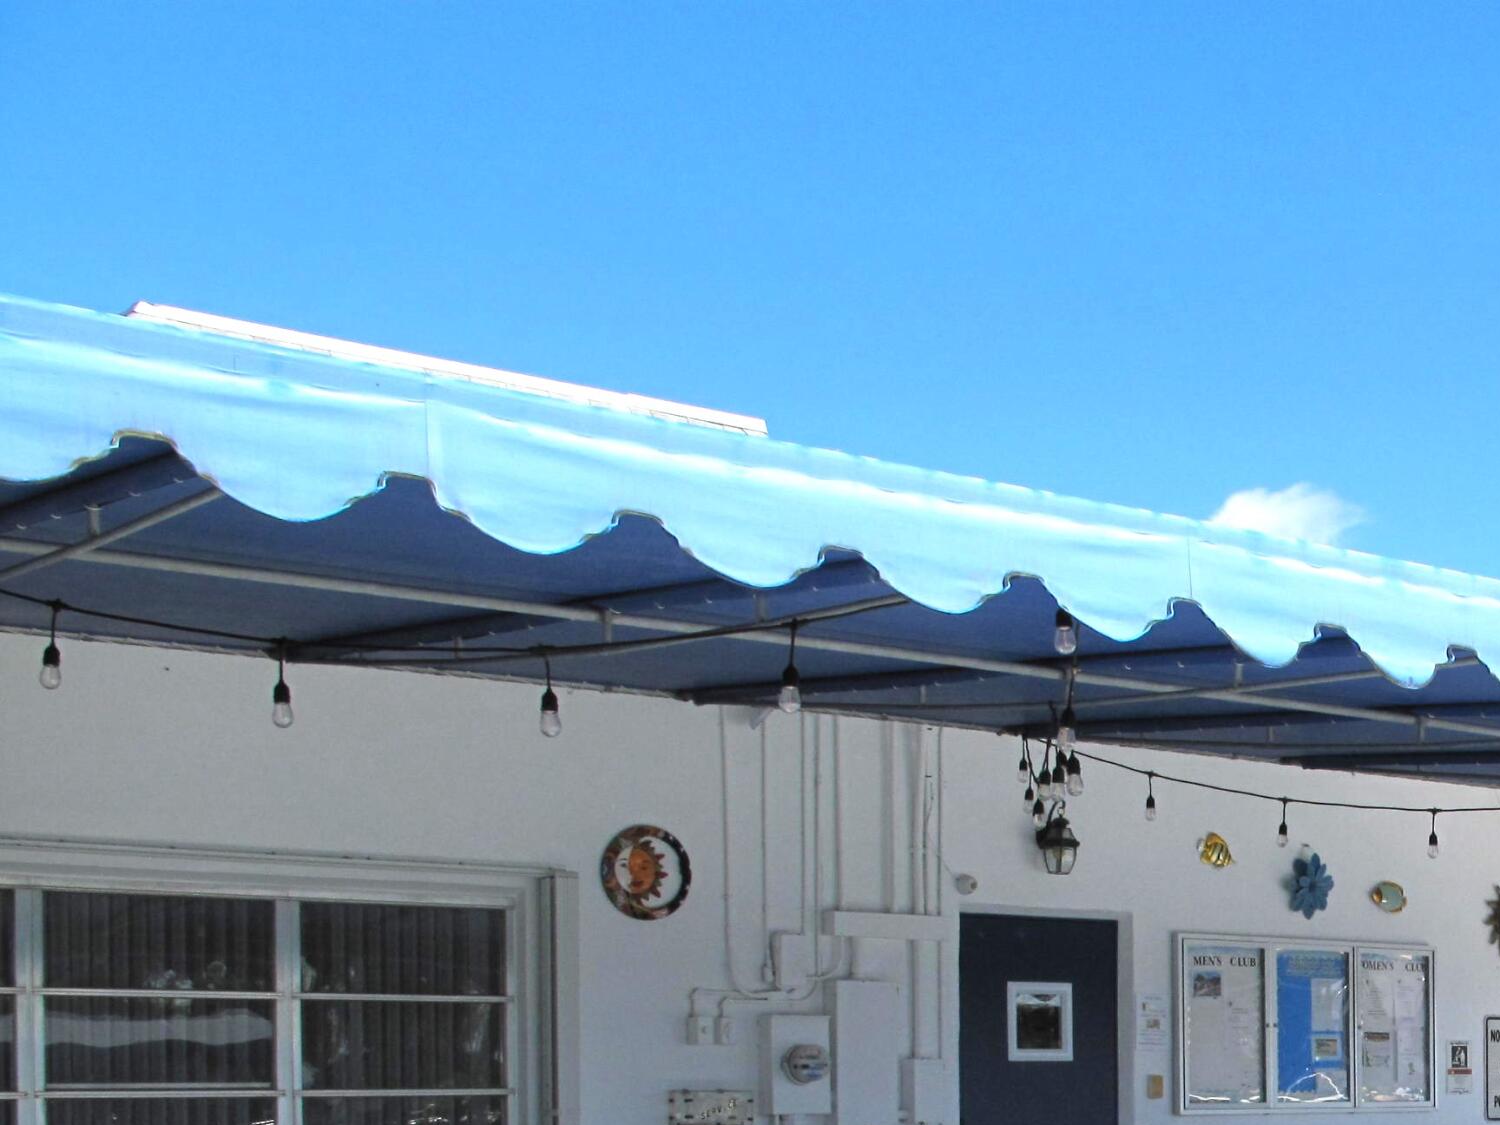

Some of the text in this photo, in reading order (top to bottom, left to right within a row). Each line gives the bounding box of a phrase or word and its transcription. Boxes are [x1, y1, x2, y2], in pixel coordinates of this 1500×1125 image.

[1193, 956, 1257, 967] MEN'S CLUB
[1360, 960, 1394, 971] OMEN'S
[1490, 1029, 1500, 1042] NO
